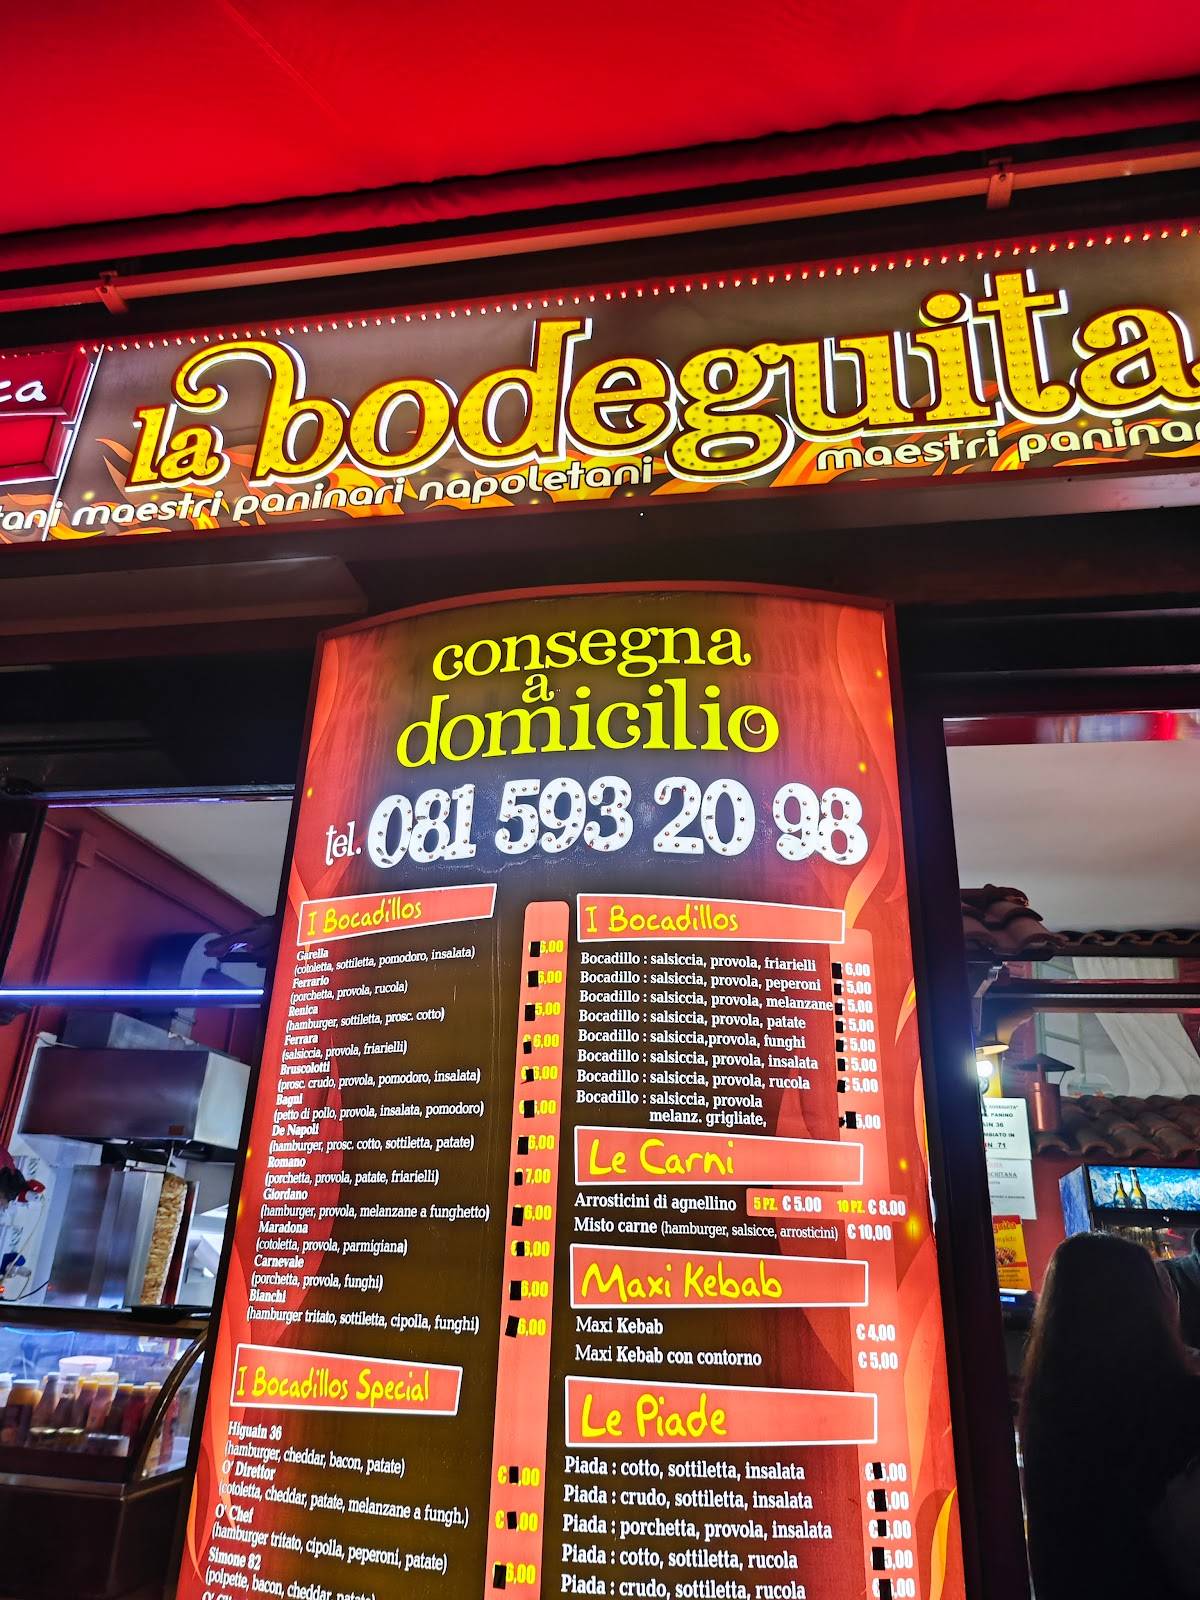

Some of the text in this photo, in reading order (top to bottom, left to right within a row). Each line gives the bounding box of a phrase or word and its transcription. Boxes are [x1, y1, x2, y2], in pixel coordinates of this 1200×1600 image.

[171, 268, 1200, 484] bodeguita
[126, 404, 230, 490] la
[816, 428, 998, 471] maestri
[71, 456, 652, 526] maestri paninari napoletani
[432, 624, 751, 681] consegna
[523, 673, 554, 703] a
[397, 678, 779, 768] domicilio
[325, 775, 869, 869] tel. 081 593 20 98
[307, 896, 422, 936] I Bocadillos
[585, 904, 738, 932] I Bocadillos
[294, 946, 475, 976] (cotoletta, sottiletta, pomodoro, insalata)
[297, 949, 328, 960] Garella
[581, 952, 870, 977] Bocadillo salsiccia, provola, friarielli 6,00
[290, 981, 408, 1005] (porchetta, provola, rucola)
[292, 976, 329, 988] Ferrario
[580, 971, 871, 995] Bocadillo salsiccia, provola, peperoni 5,00
[288, 1005, 318, 1017] Renica
[580, 990, 834, 1011] Bocadillo salsiccia, melanzane
[286, 1007, 445, 1033] (hamburger, sottiletta, prosc. cotto)
[767, 1017, 806, 1029] patate
[284, 1034, 318, 1045] Ferrara
[364, 1041, 407, 1055] friarielli)
[764, 1035, 805, 1051] funghi
[280, 1061, 330, 1075] Bruscolotti
[277, 1069, 480, 1093] (prosc. crudo, pomodoro, insalata)
[769, 1077, 878, 1092] rucola 5,00
[274, 1101, 484, 1123] (petto di pollo, insalata, pomodoro)
[650, 1109, 767, 1127] melanz. grigliate,
[272, 1122, 319, 1136] De Napoli
[269, 1136, 474, 1154] (hamburger, prosc. cotto, sottiletta, patate)
[589, 1138, 734, 1175] Le Carni
[268, 1156, 306, 1168] Romano
[265, 1170, 439, 1186] (porchetta, patate, friarielli)
[263, 1188, 308, 1200] Giordano
[574, 1193, 650, 1209] Arrosticini
[654, 1194, 668, 1209] di
[671, 1195, 736, 1213] agnellino
[753, 1197, 761, 1211] 5
[782, 1196, 792, 1212] €
[837, 1200, 849, 1213] 10
[868, 1200, 877, 1214] €
[261, 1205, 489, 1221] (hamburger, melanzane a funghetto)
[259, 1222, 308, 1233] Maradona
[574, 1217, 892, 1241] Misto carne salsicce, arrosticini) € 10,00
[256, 1238, 407, 1255] (cotoletta, parmigiana)
[254, 1255, 304, 1267] Carnevale
[251, 1271, 383, 1291] (porchetta, funghi)
[582, 1259, 783, 1303] Maxi Kebab
[305, 1310, 479, 1334] tritato, cipolla, funghi)
[576, 1316, 896, 1342] Maxi Kebab € 4,00
[575, 1344, 898, 1370] Maxi Kebab con contorno € 5,00
[236, 1366, 429, 1408] I Bocadillos Special
[581, 1392, 728, 1438] Le Piade
[228, 1421, 282, 1439] Higuain 36
[284, 1446, 363, 1470] cheddar, bacon,
[565, 1456, 663, 1479] Piada cotto,
[236, 1462, 276, 1481] Direttor
[265, 1487, 469, 1527] cheddar, melanzane fungh.)
[563, 1484, 671, 1508] Piada crudo,
[229, 1507, 253, 1523] Chef
[562, 1513, 607, 1534] Piada
[208, 1547, 261, 1570] Simone 82
[306, 1538, 401, 1568] cipolla, peperoni,
[748, 1551, 798, 1569] rucola
[205, 1566, 249, 1591] (polpette,
[252, 1577, 285, 1596] bacon,
